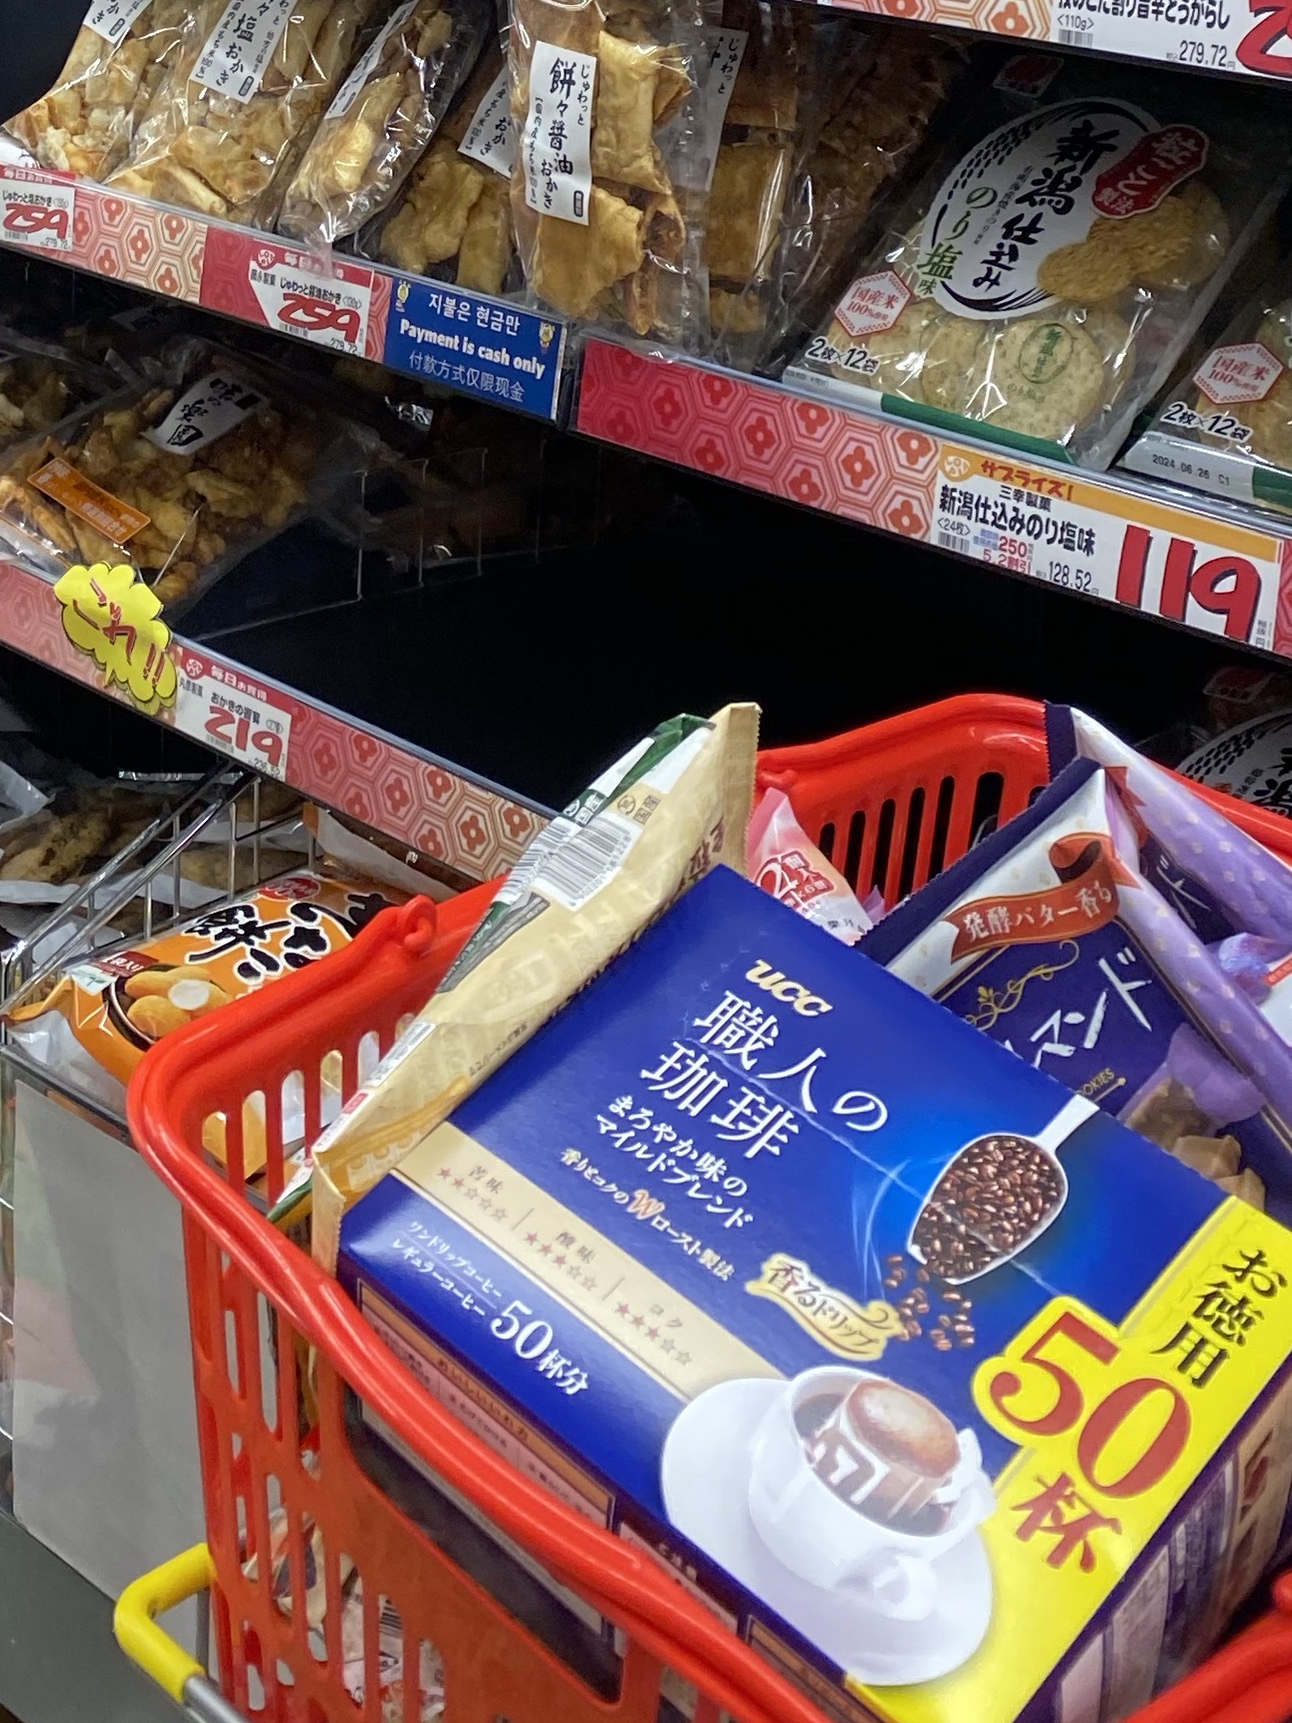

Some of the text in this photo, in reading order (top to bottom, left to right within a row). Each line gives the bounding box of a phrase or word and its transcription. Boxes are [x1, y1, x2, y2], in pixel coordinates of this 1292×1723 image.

[1179, 41, 1227, 68] 279.72
[576, 64, 590, 127] じゅわっと
[3, 203, 69, 240] 259
[973, 119, 1120, 291] 新潟仕込み
[916, 186, 998, 295] のり塩味
[277, 293, 361, 343] 259
[429, 292, 520, 337] 지불은 현금만
[850, 285, 899, 310] 国産米
[399, 318, 546, 380] Payment is cash only
[408, 352, 526, 403] 付款方式仅限现金
[805, 337, 880, 375] 2枚×12袋
[1212, 355, 1271, 382] 国産米
[1164, 402, 1252, 442] 2枚×12袋
[981, 460, 1074, 501] サプライズ!
[998, 484, 1053, 513] 三幸製菓
[939, 484, 1096, 558] 新潟仕込みのり塩味
[999, 537, 1028, 558] 250
[1048, 561, 1093, 593] 128.52
[1115, 524, 1263, 644] 119
[204, 705, 283, 768] 219
[694, 990, 889, 1132] 職人の
[640, 1041, 800, 1159] 珈琲
[596, 1113, 754, 1229] マイルドブレンド
[609, 1094, 748, 1197] まろやか味の
[390, 1237, 487, 1318] レギュラーコーヒー
[407, 1220, 504, 1299] ワンドリップコーヒー
[763, 1258, 879, 1350] 香るドリップ
[1148, 1248, 1288, 1390] お徳用
[489, 1300, 590, 1397] 50杯分
